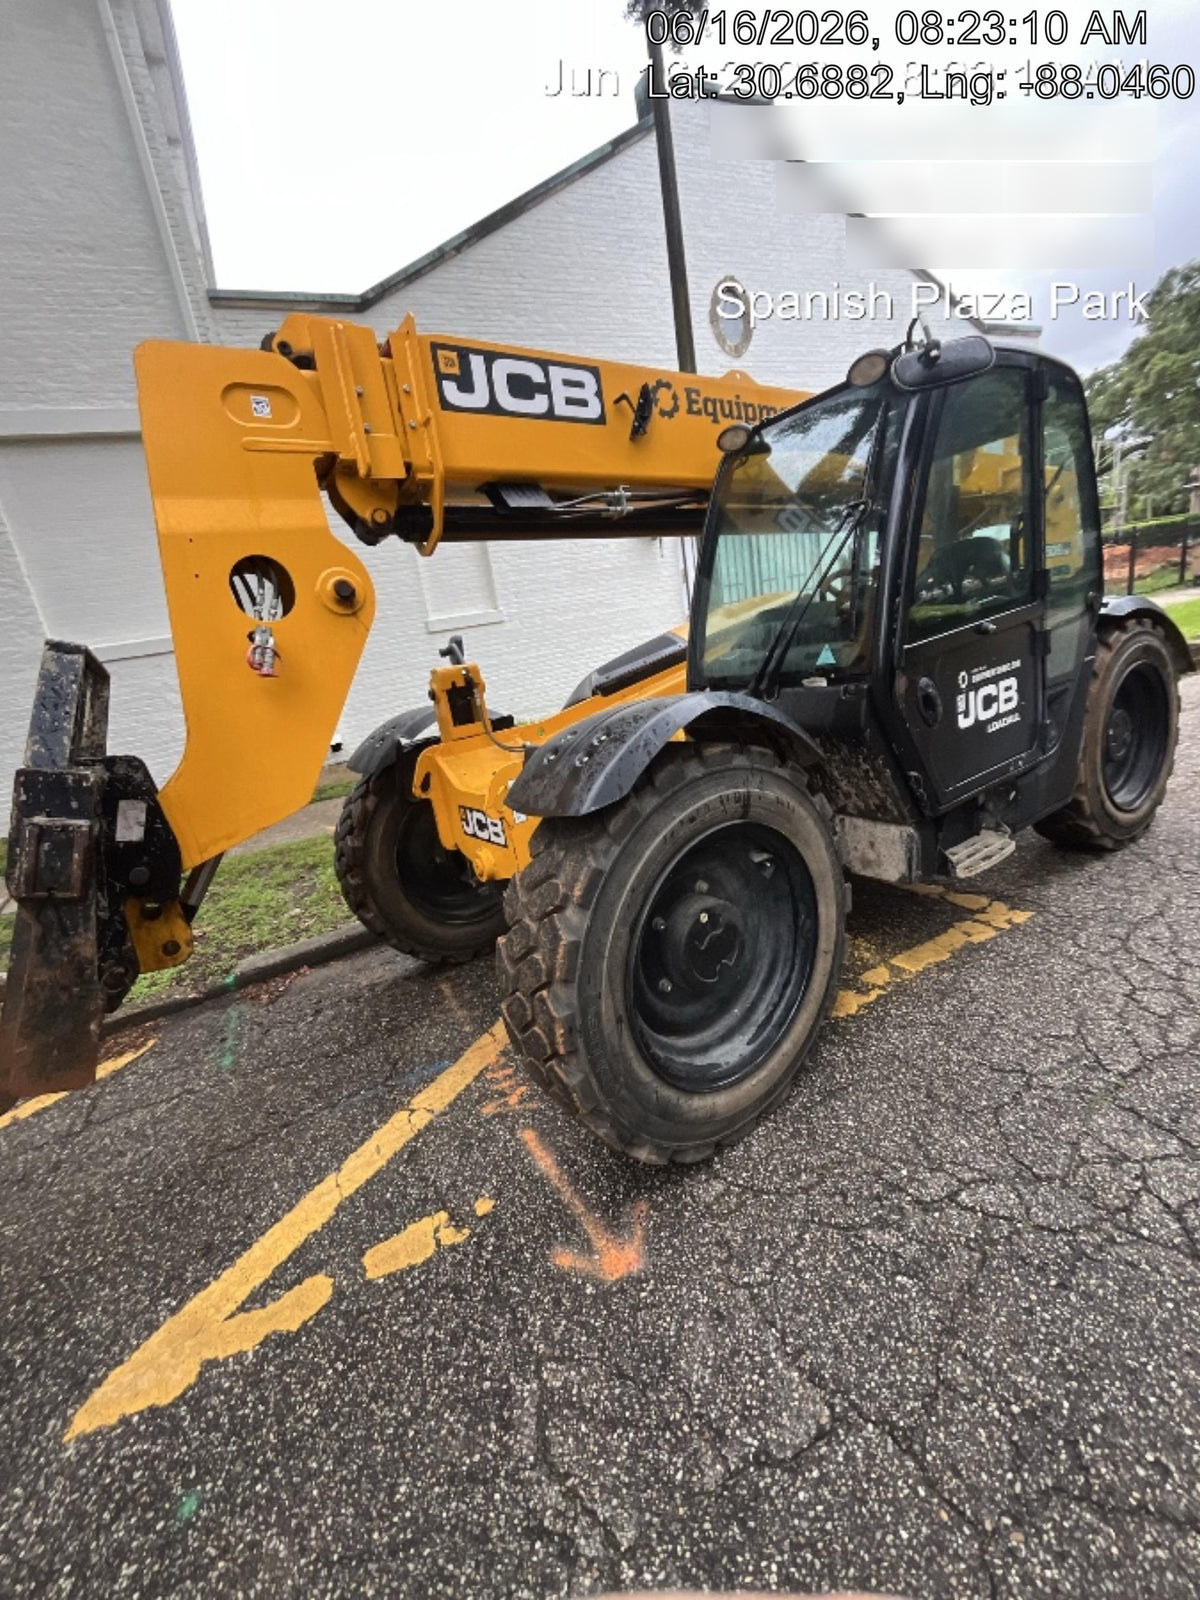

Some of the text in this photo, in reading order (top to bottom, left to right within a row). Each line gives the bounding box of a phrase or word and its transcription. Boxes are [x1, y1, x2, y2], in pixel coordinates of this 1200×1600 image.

[441, 353, 602, 420] JCB
[684, 386, 789, 424] Equipm
[957, 676, 1019, 730] JCB
[462, 808, 506, 846] JCB
